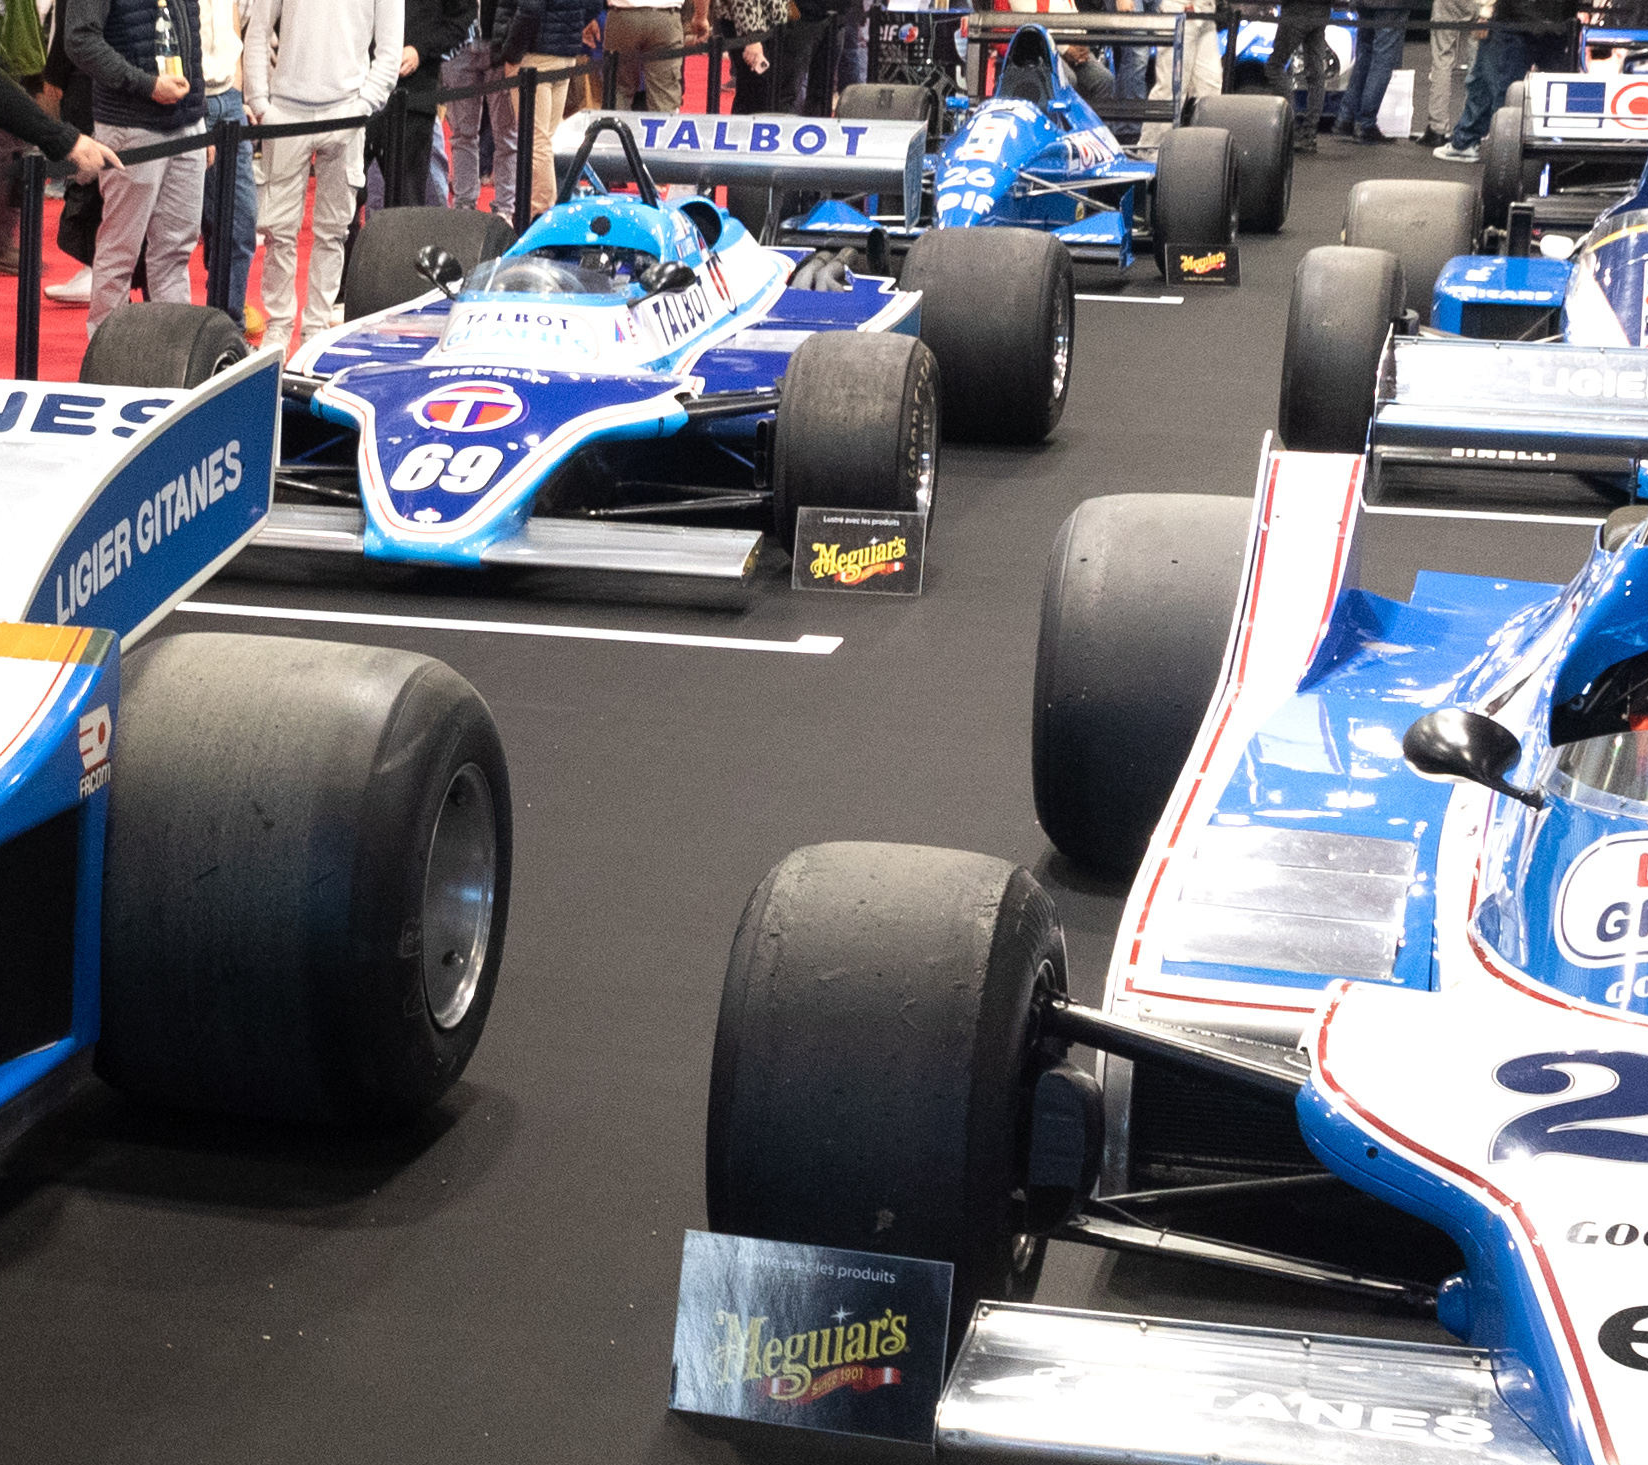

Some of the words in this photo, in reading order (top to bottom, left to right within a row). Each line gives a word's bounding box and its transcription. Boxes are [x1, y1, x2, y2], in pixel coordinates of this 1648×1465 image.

[638, 117, 870, 158] TALBOT
[943, 167, 996, 188] 26
[652, 275, 714, 347] TALBOT
[390, 443, 505, 494] 69
[56, 527, 131, 625] LIGIER
[135, 438, 243, 553] GITANES
[810, 536, 906, 583] Meguiar's
[816, 1261, 835, 1275] les
[836, 1264, 897, 1285] produits
[713, 1307, 908, 1402] Meguiar's
[1201, 1387, 1495, 1445] TANES
